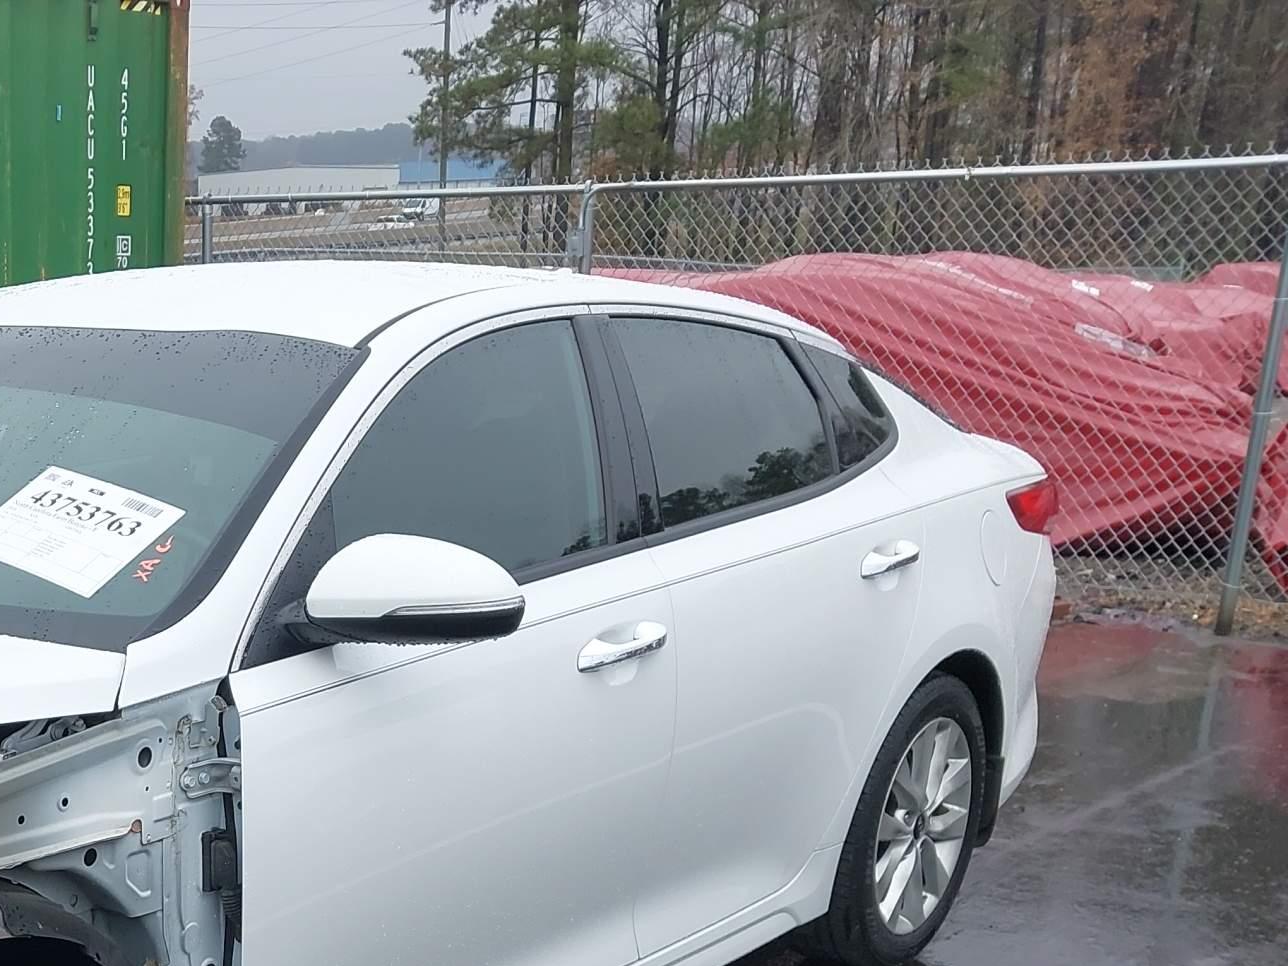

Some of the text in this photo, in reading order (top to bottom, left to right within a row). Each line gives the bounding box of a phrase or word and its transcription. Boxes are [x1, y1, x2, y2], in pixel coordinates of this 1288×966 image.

[87, 65, 95, 160] UACU
[120, 68, 129, 161] 45G1
[30, 489, 142, 537] 43753763
